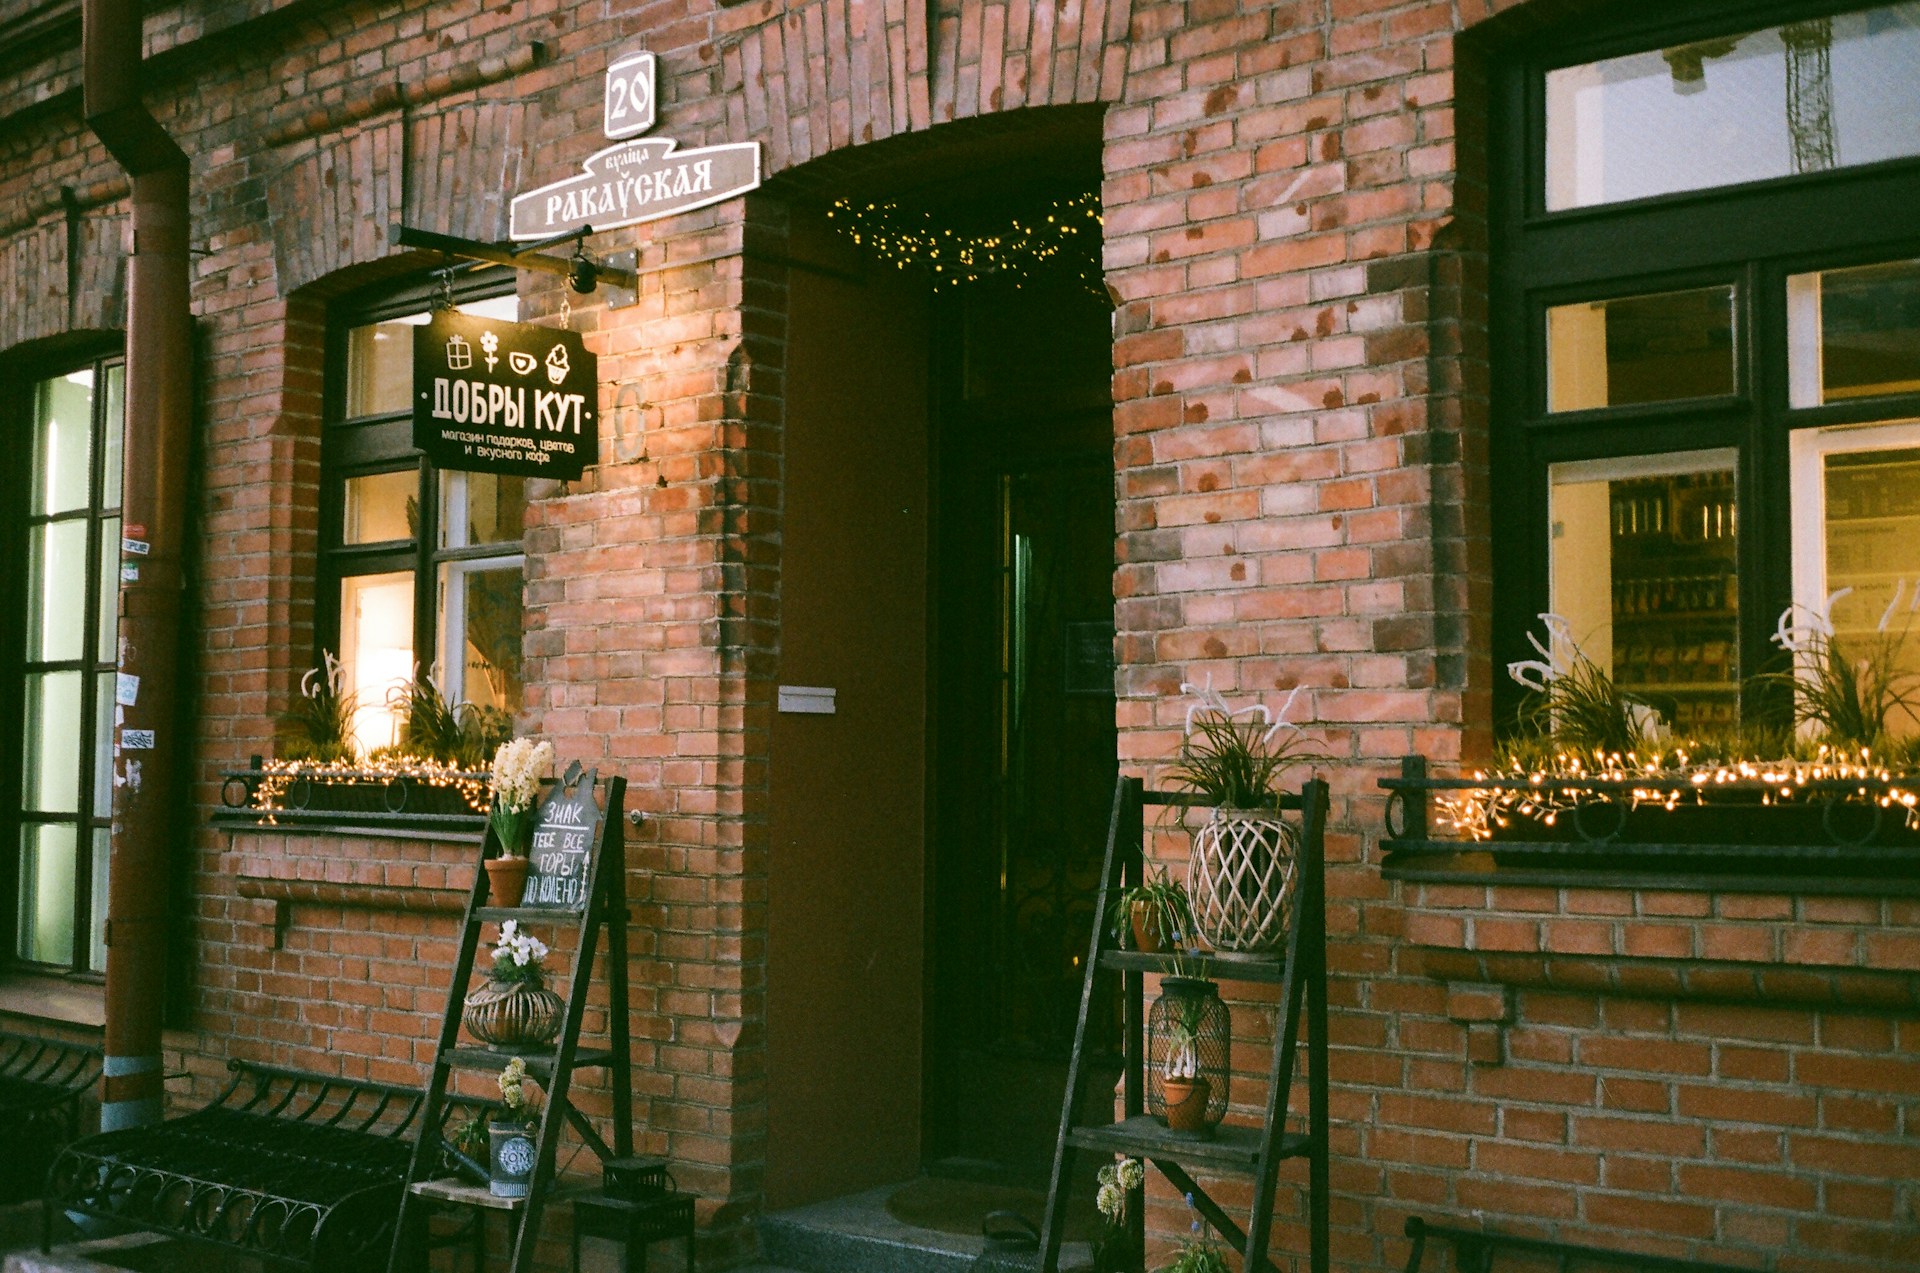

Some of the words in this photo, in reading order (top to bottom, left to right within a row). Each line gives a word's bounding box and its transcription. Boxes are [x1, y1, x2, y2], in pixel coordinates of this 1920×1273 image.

[610, 71, 650, 120] 20
[544, 158, 713, 226] РАКАЎСКАЯ
[431, 377, 525, 429] ДОБРЫ
[534, 388, 585, 435] КУТ
[441, 429, 484, 443] магазин
[486, 433, 536, 451] подарков,
[539, 439, 575, 455] цветов
[464, 444, 472, 455] и
[476, 444, 523, 461] вкусного
[525, 450, 551, 465] кофе
[544, 801, 584, 825] ЗНАК
[533, 831, 557, 849] ТЕБЕ
[562, 832, 585, 850] ВСЕ
[540, 852, 576, 877] ГОРЫ
[539, 875, 578, 905] КОЛЕНО
